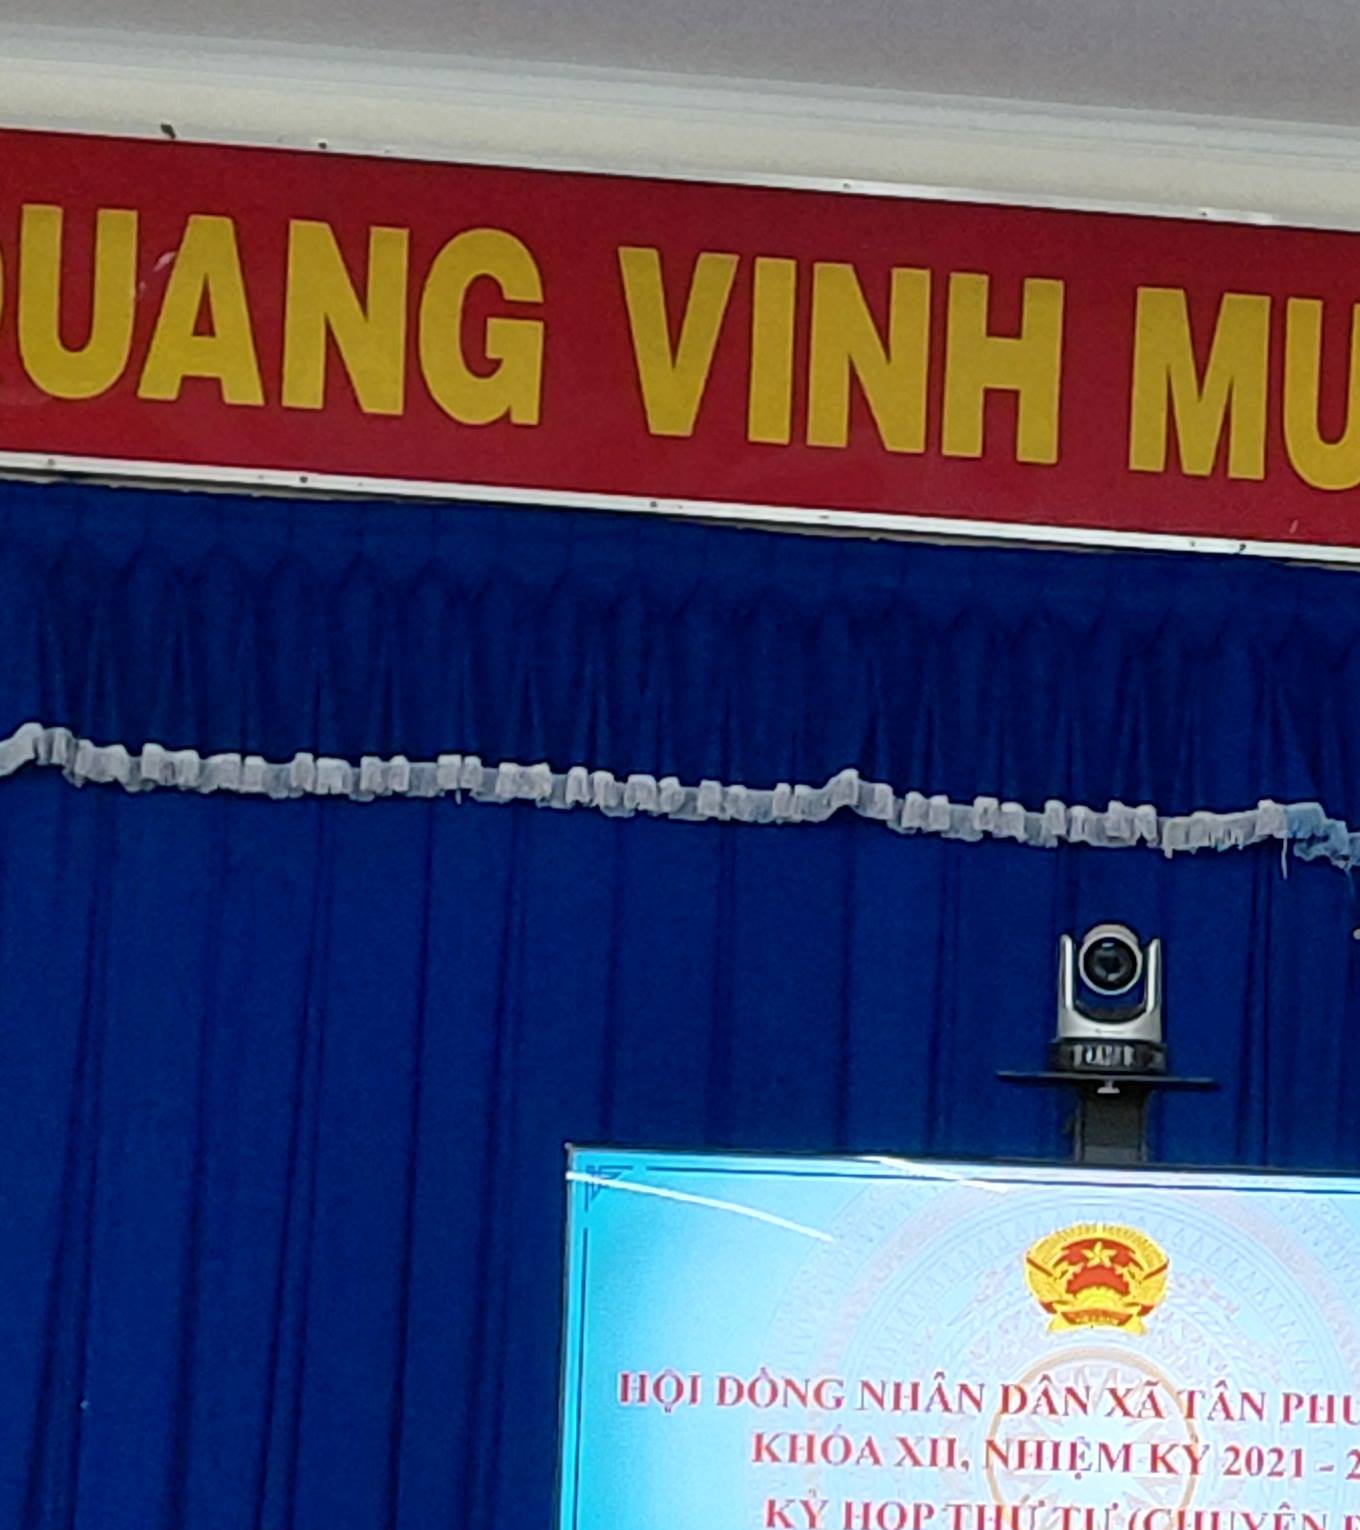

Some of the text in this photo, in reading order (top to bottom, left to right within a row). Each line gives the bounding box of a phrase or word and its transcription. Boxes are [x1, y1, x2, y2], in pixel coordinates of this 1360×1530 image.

[0, 203, 545, 426] UANG
[618, 246, 1065, 465] VINH
[619, 1367, 701, 1414] HỘI
[854, 1371, 986, 1415] NHÂN
[1000, 1373, 1091, 1417] DÂN
[1104, 1379, 1165, 1420] XÃ
[1177, 1380, 1267, 1424] TÂN
[893, 1435, 970, 1472] XII,
[983, 1435, 1134, 1481] NHIỆM
[1222, 1445, 1304, 1479] 2021
